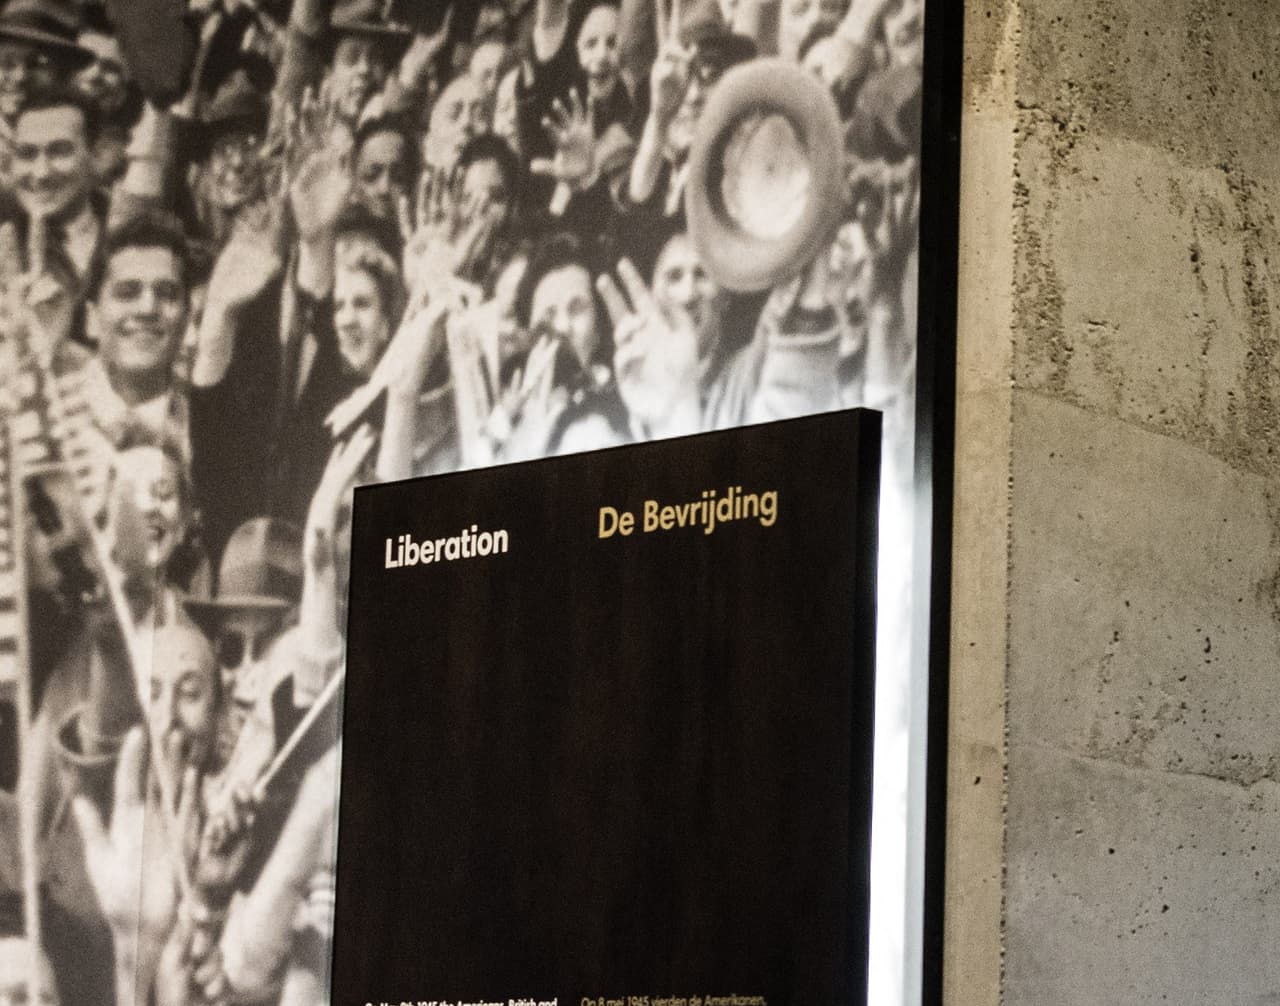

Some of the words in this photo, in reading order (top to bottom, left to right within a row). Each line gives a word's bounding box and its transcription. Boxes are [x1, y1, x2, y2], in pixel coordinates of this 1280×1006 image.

[599, 506, 634, 538] De
[644, 486, 778, 535] Bevrijding
[385, 524, 508, 568] Liberation
